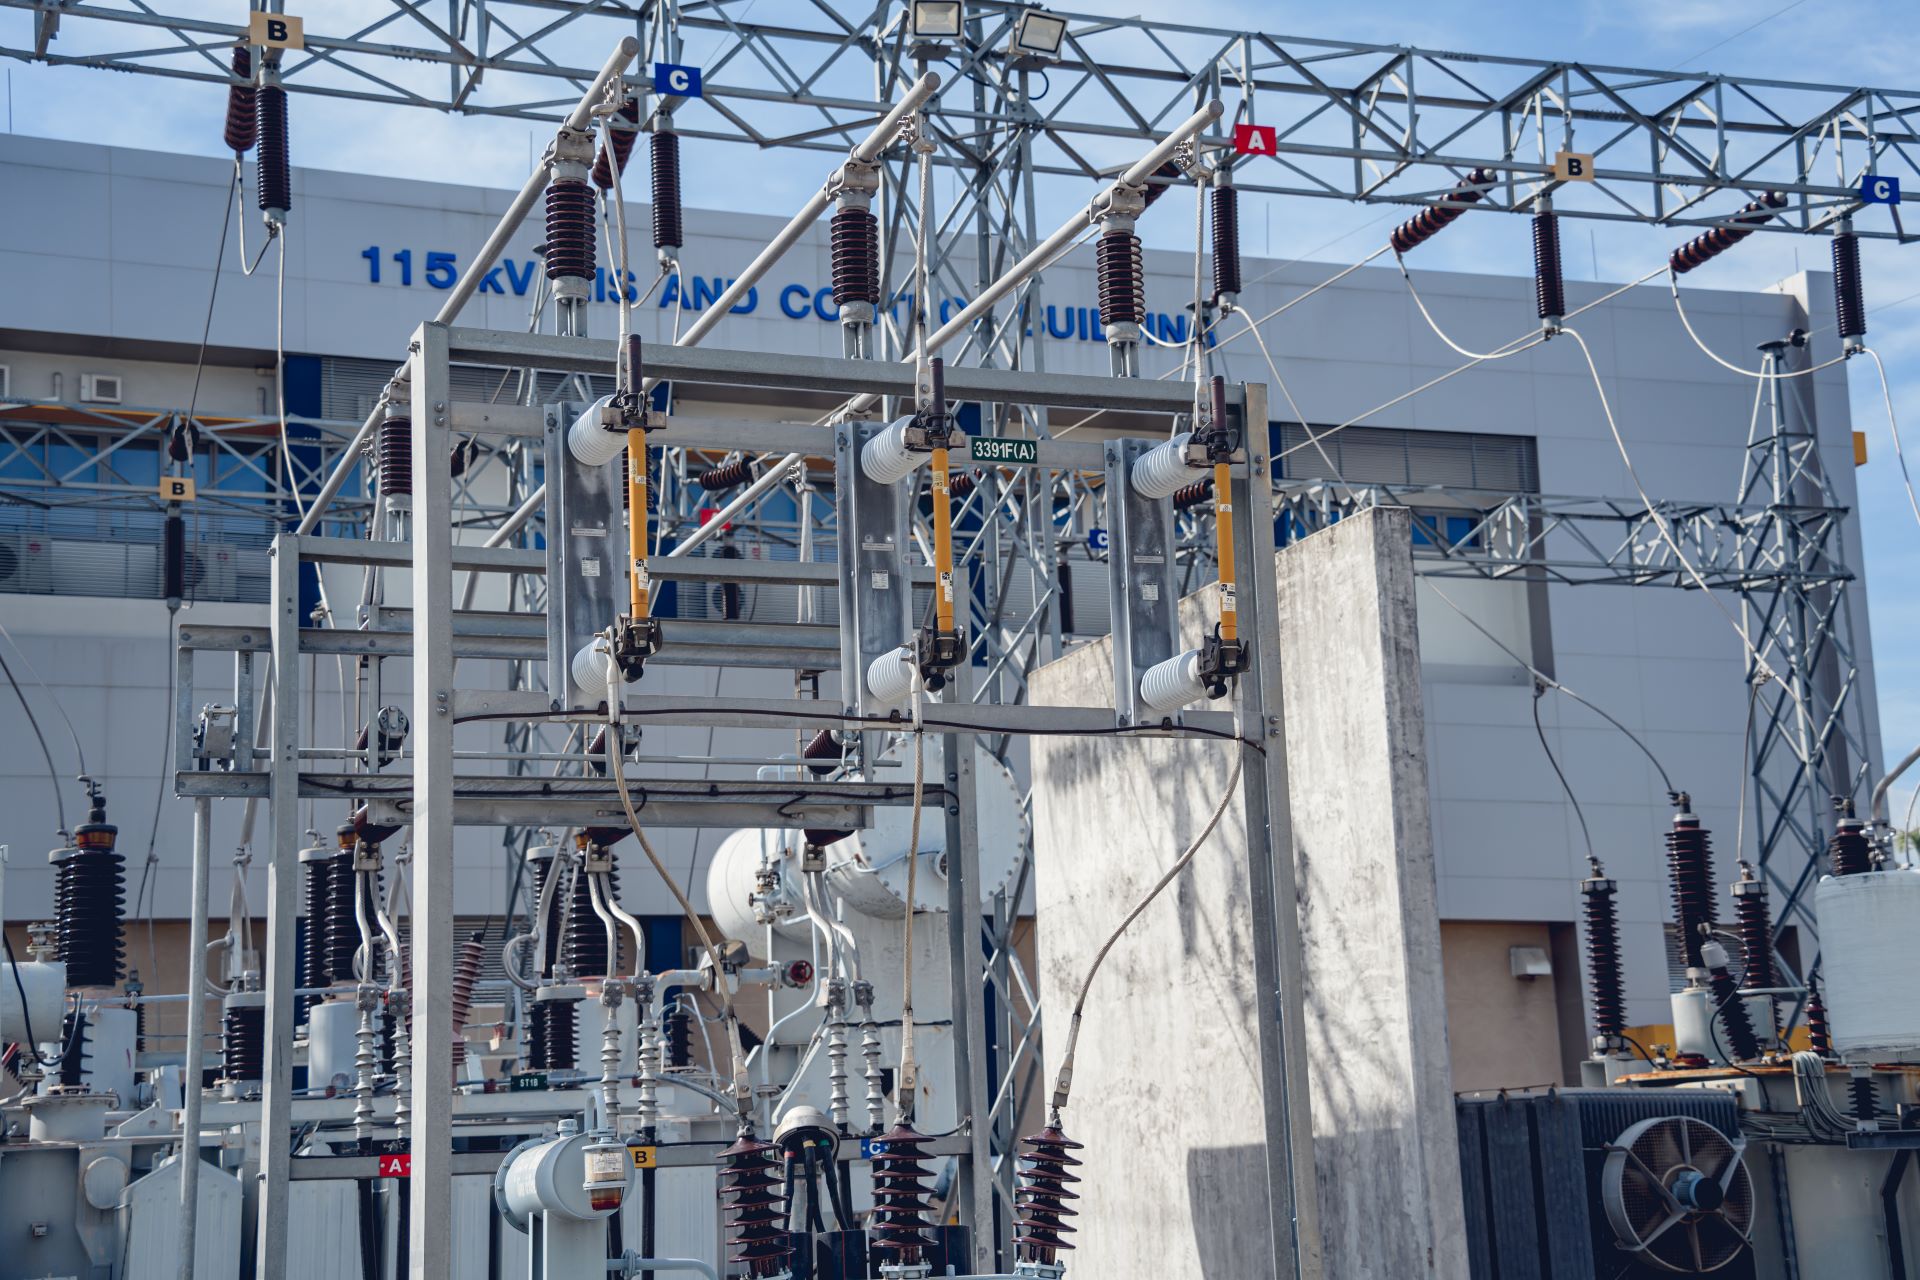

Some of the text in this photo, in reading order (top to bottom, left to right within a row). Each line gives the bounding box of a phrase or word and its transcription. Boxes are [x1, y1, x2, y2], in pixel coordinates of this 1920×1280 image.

[267, 19, 288, 42] B
[669, 70, 689, 91] C
[1247, 130, 1266, 151] A
[1568, 158, 1583, 176] B
[1874, 180, 1890, 200] C
[361, 246, 458, 290] 115
[478, 259, 536, 296] kV
[658, 274, 758, 315] AND
[1018, 303, 1217, 347] UILIN
[974, 441, 1036, 460] 3391F(A)
[172, 482, 185, 496] B
[1096, 532, 1109, 547] C
[635, 1150, 648, 1164] B
[869, 1142, 881, 1155] C
[389, 1158, 403, 1173] A
